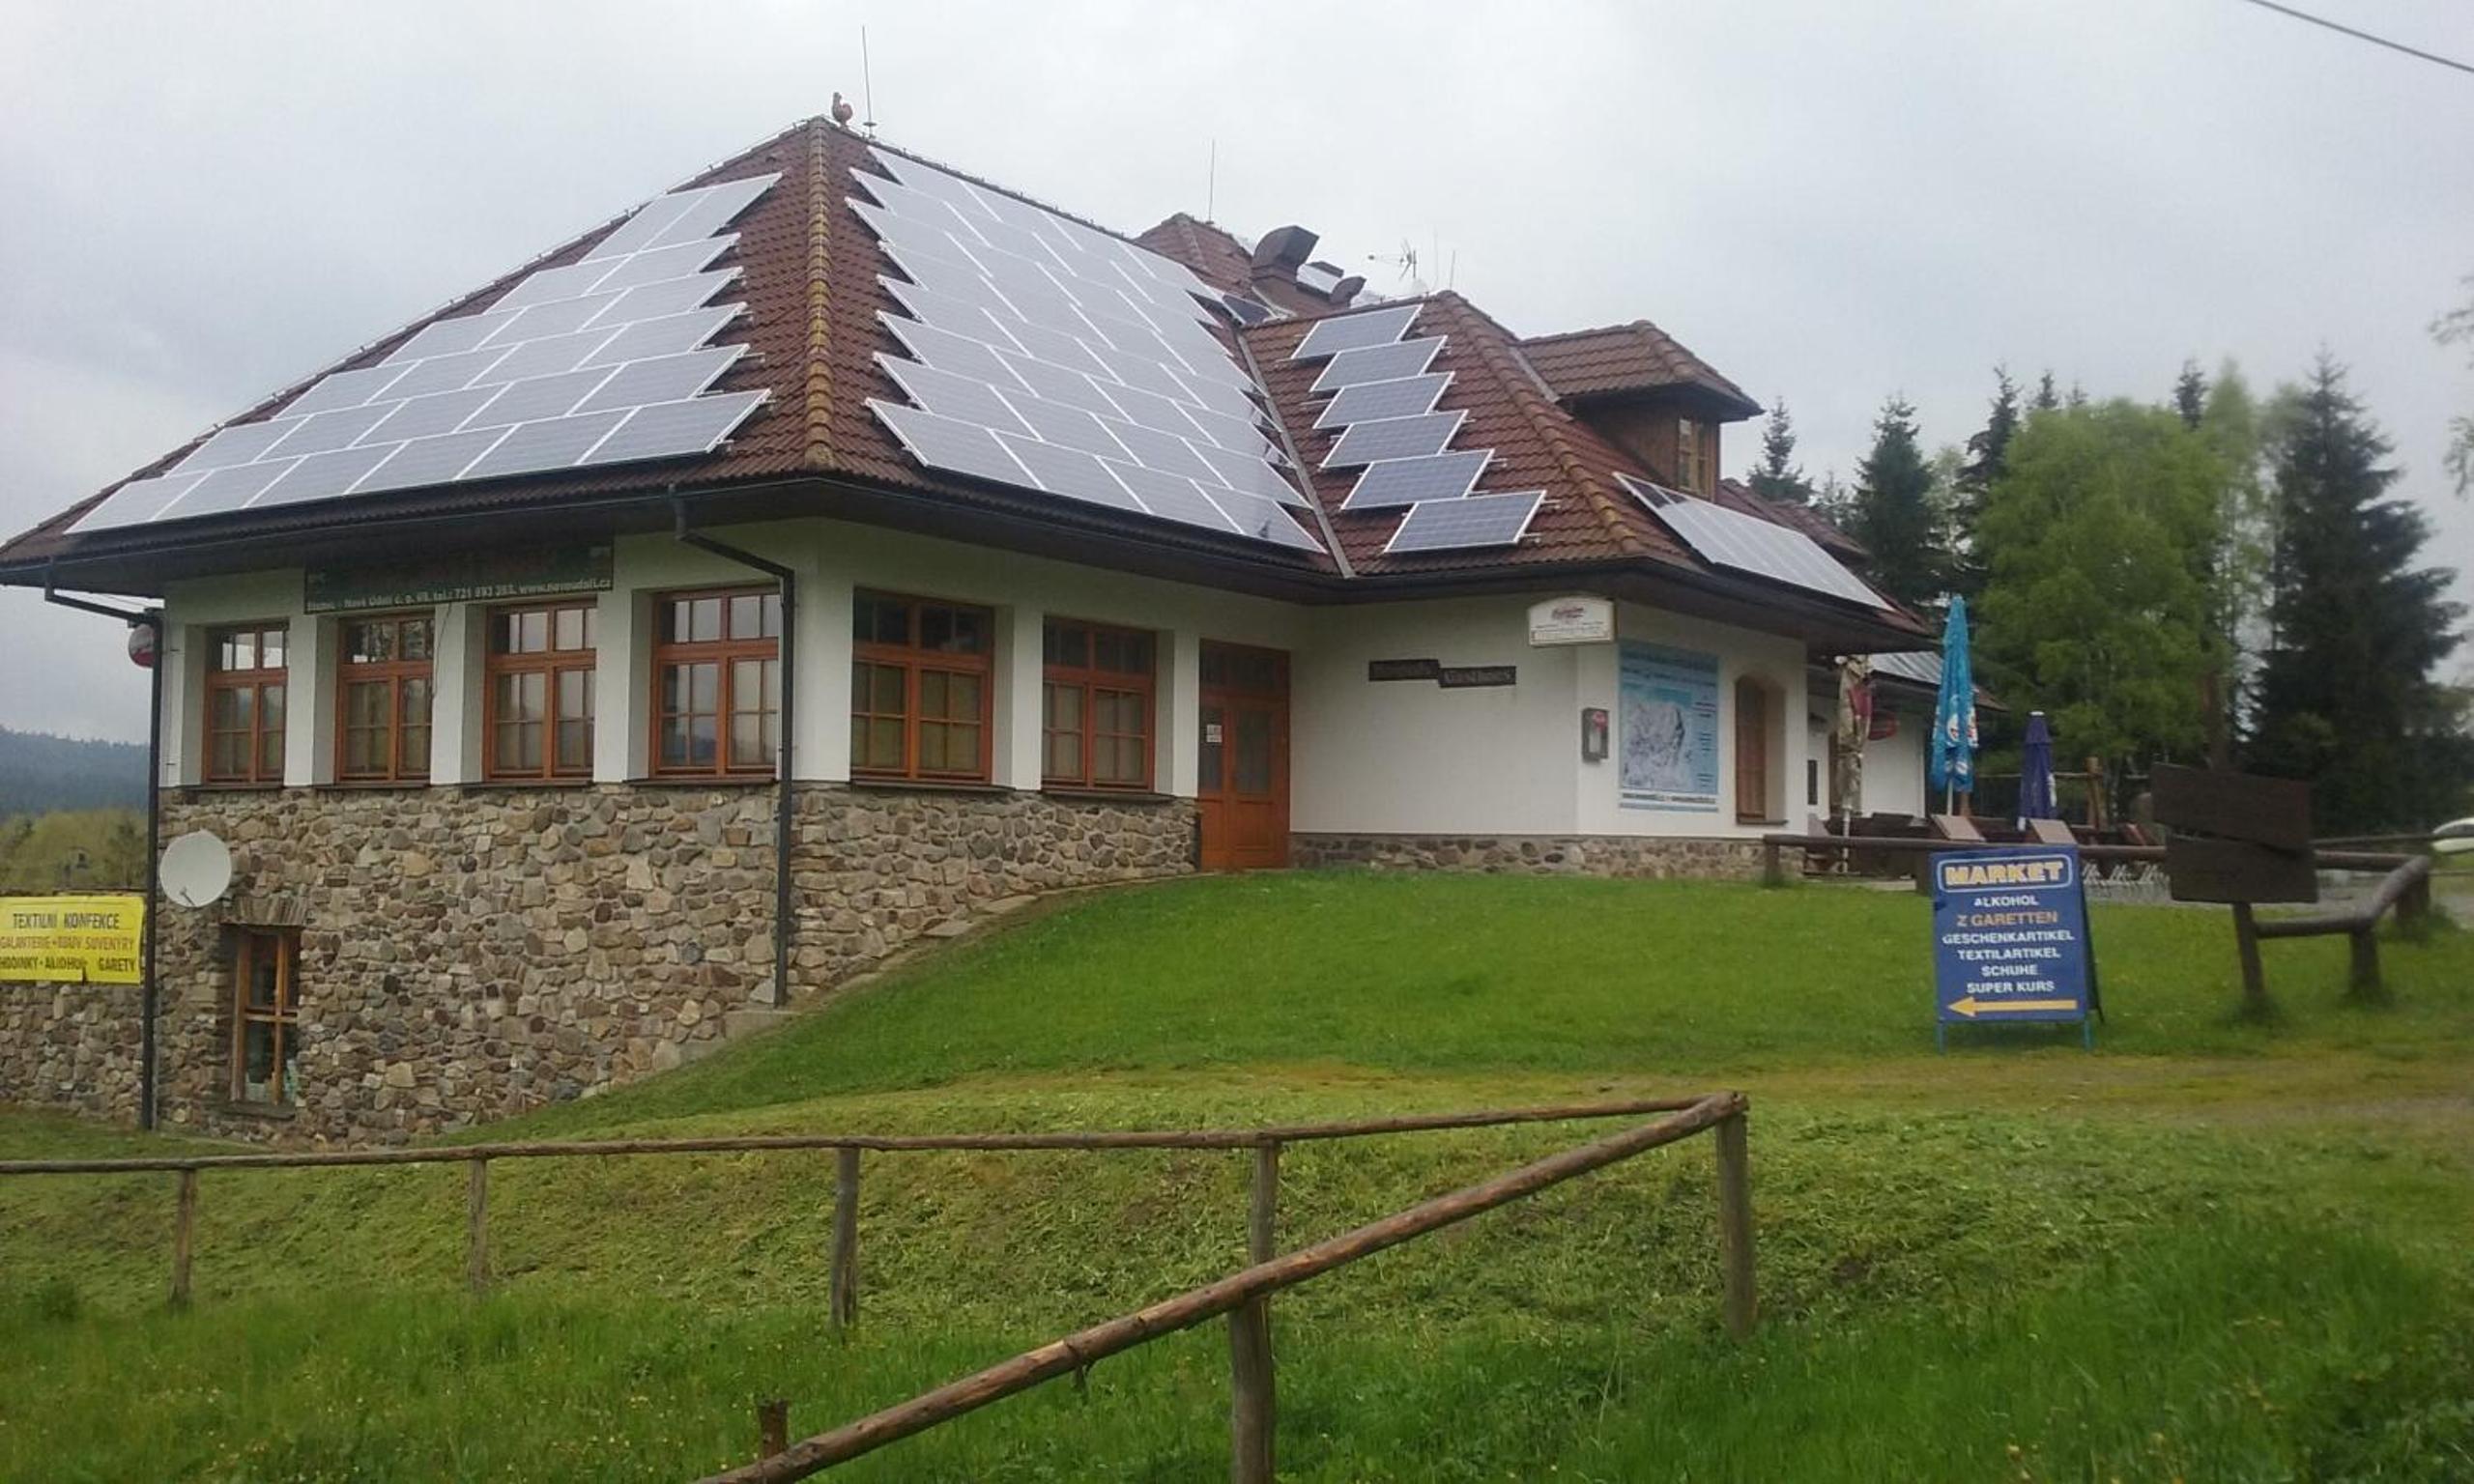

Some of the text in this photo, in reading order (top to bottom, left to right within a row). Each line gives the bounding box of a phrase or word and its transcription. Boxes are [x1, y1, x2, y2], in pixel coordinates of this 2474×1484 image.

[1944, 861, 2064, 886] MARKET
[1973, 895, 2039, 907] ALKOHOL
[1942, 929, 2075, 945] GESCHENKARTIKEL
[1957, 948, 2061, 960] TEXTILARTIKEL
[1980, 964, 2039, 977] SCHUHE
[1967, 979, 2056, 994] SUPER KURS
